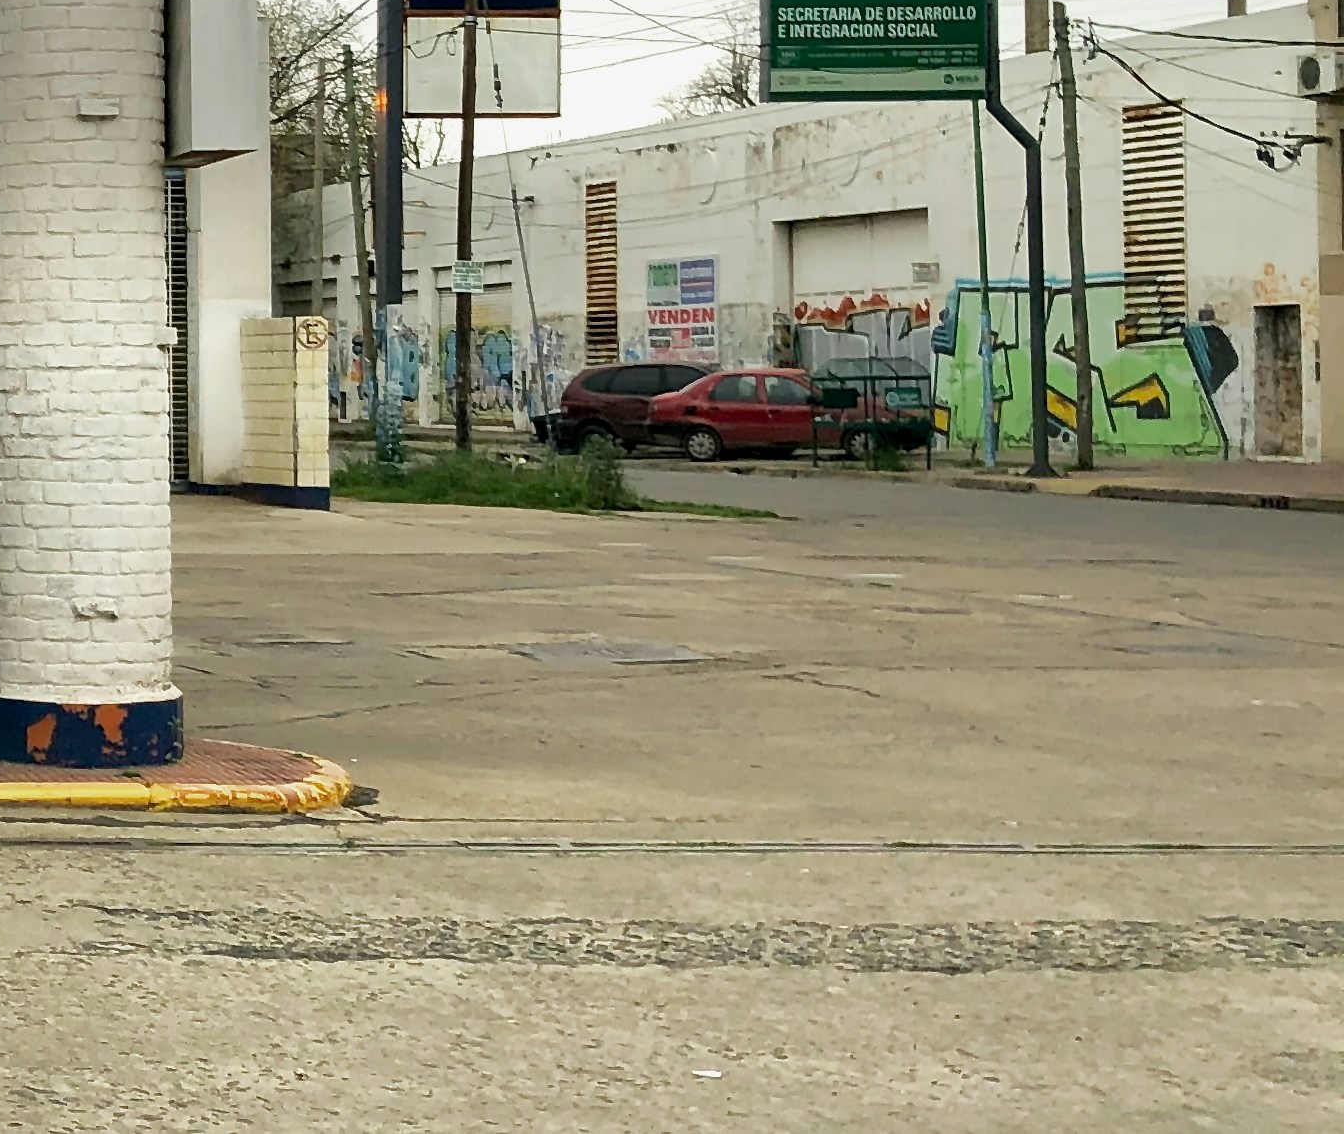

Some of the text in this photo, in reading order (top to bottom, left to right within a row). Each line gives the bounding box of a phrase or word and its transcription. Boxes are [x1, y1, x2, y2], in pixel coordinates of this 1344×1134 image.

[777, 5, 977, 22] SECRETARIA DE DESARROLLO
[777, 23, 939, 38] E INTEGRACION SOCIAL
[647, 307, 715, 325] VENDEN
